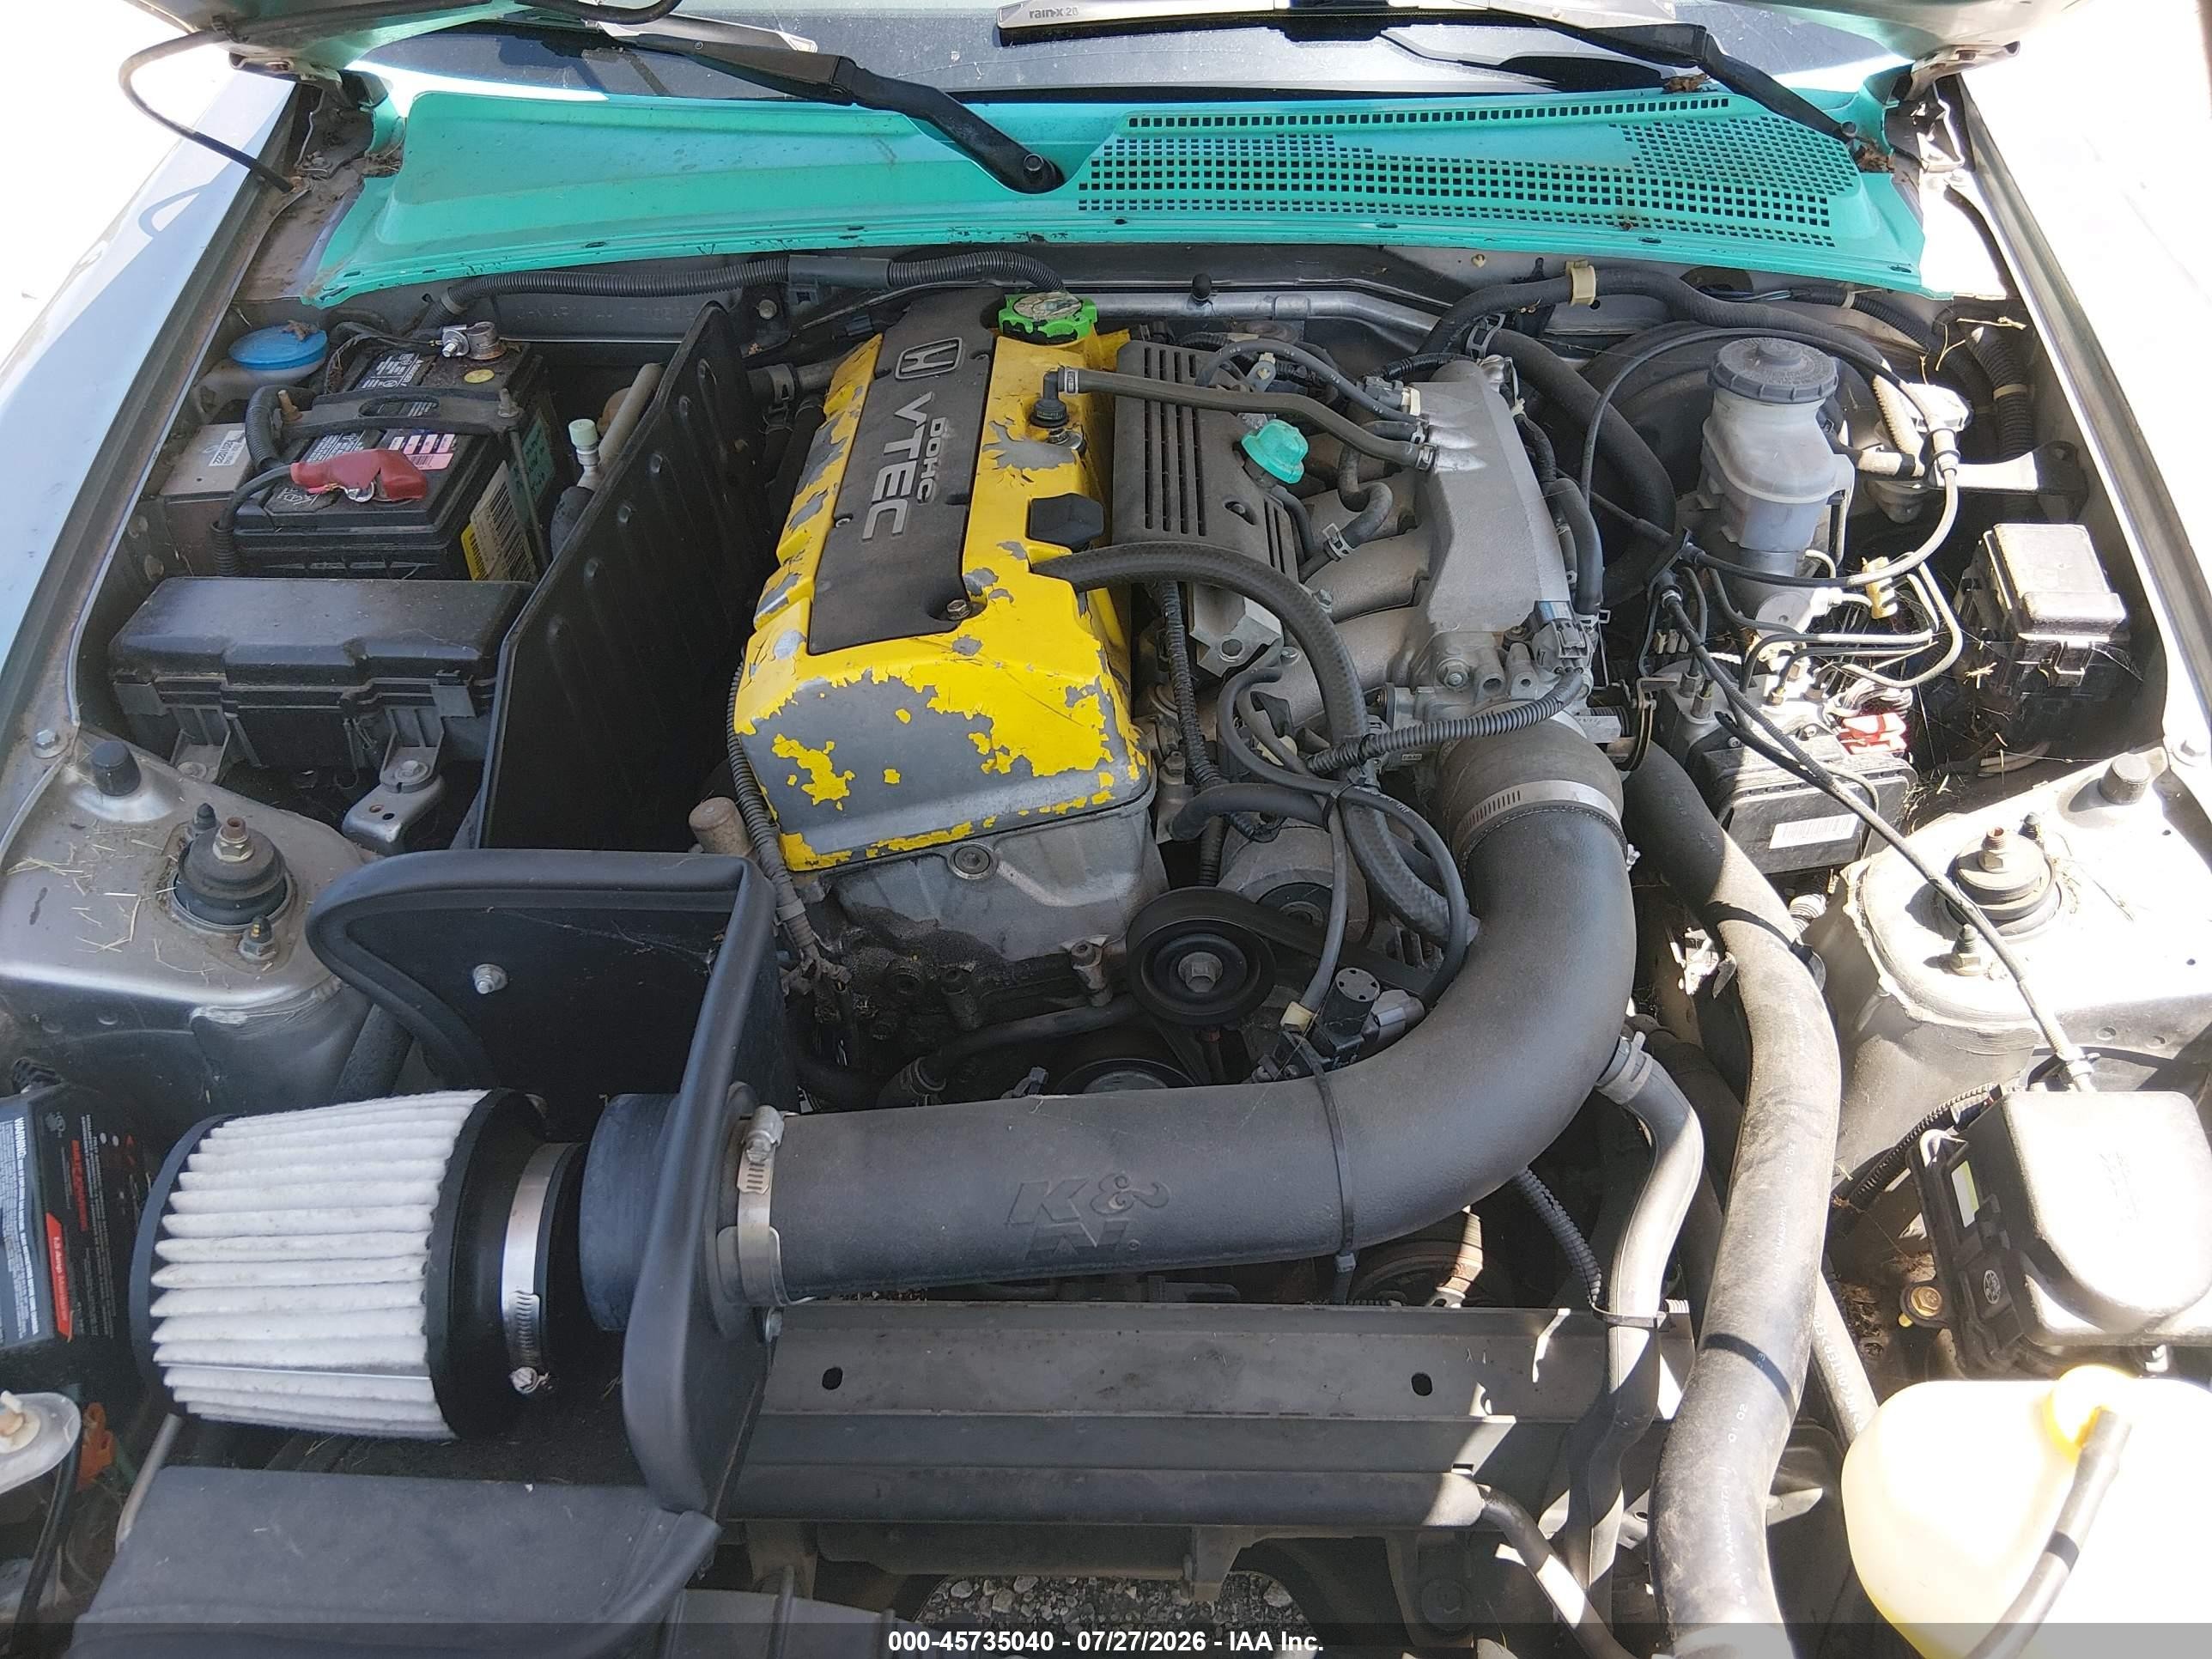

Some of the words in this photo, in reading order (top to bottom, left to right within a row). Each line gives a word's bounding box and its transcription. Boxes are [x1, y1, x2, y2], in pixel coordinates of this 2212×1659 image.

[860, 392, 934, 542] VTEC
[915, 417, 945, 503] DOHC
[1006, 1173, 1171, 1260] K&N
